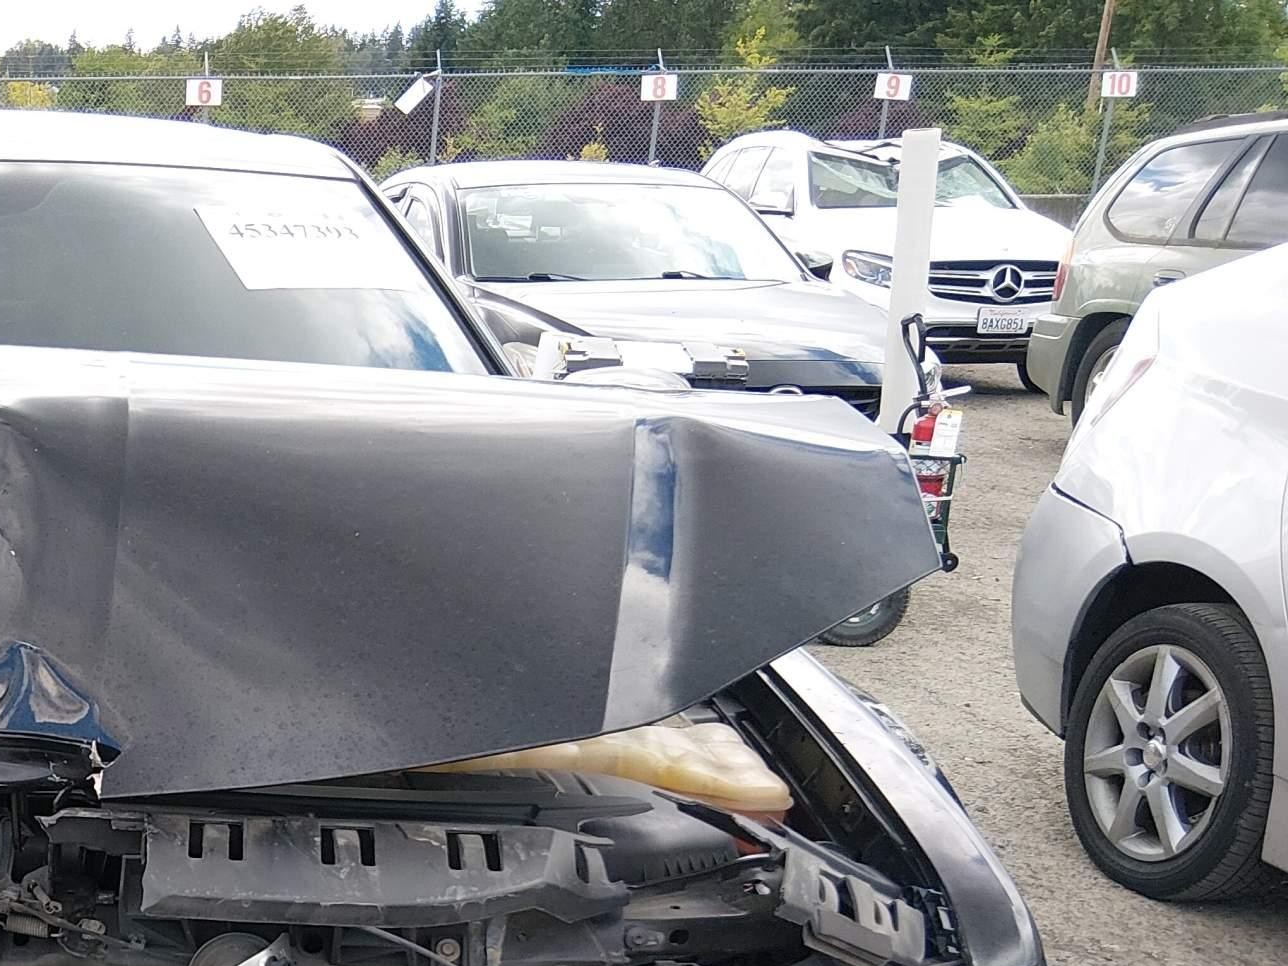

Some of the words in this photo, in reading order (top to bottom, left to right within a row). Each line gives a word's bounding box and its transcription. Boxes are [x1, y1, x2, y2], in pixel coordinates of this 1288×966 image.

[198, 81, 212, 104] 6
[652, 76, 666, 99] 8
[886, 75, 900, 98] 9
[1108, 73, 1131, 96] 10
[981, 317, 1023, 330] 8AXG851
